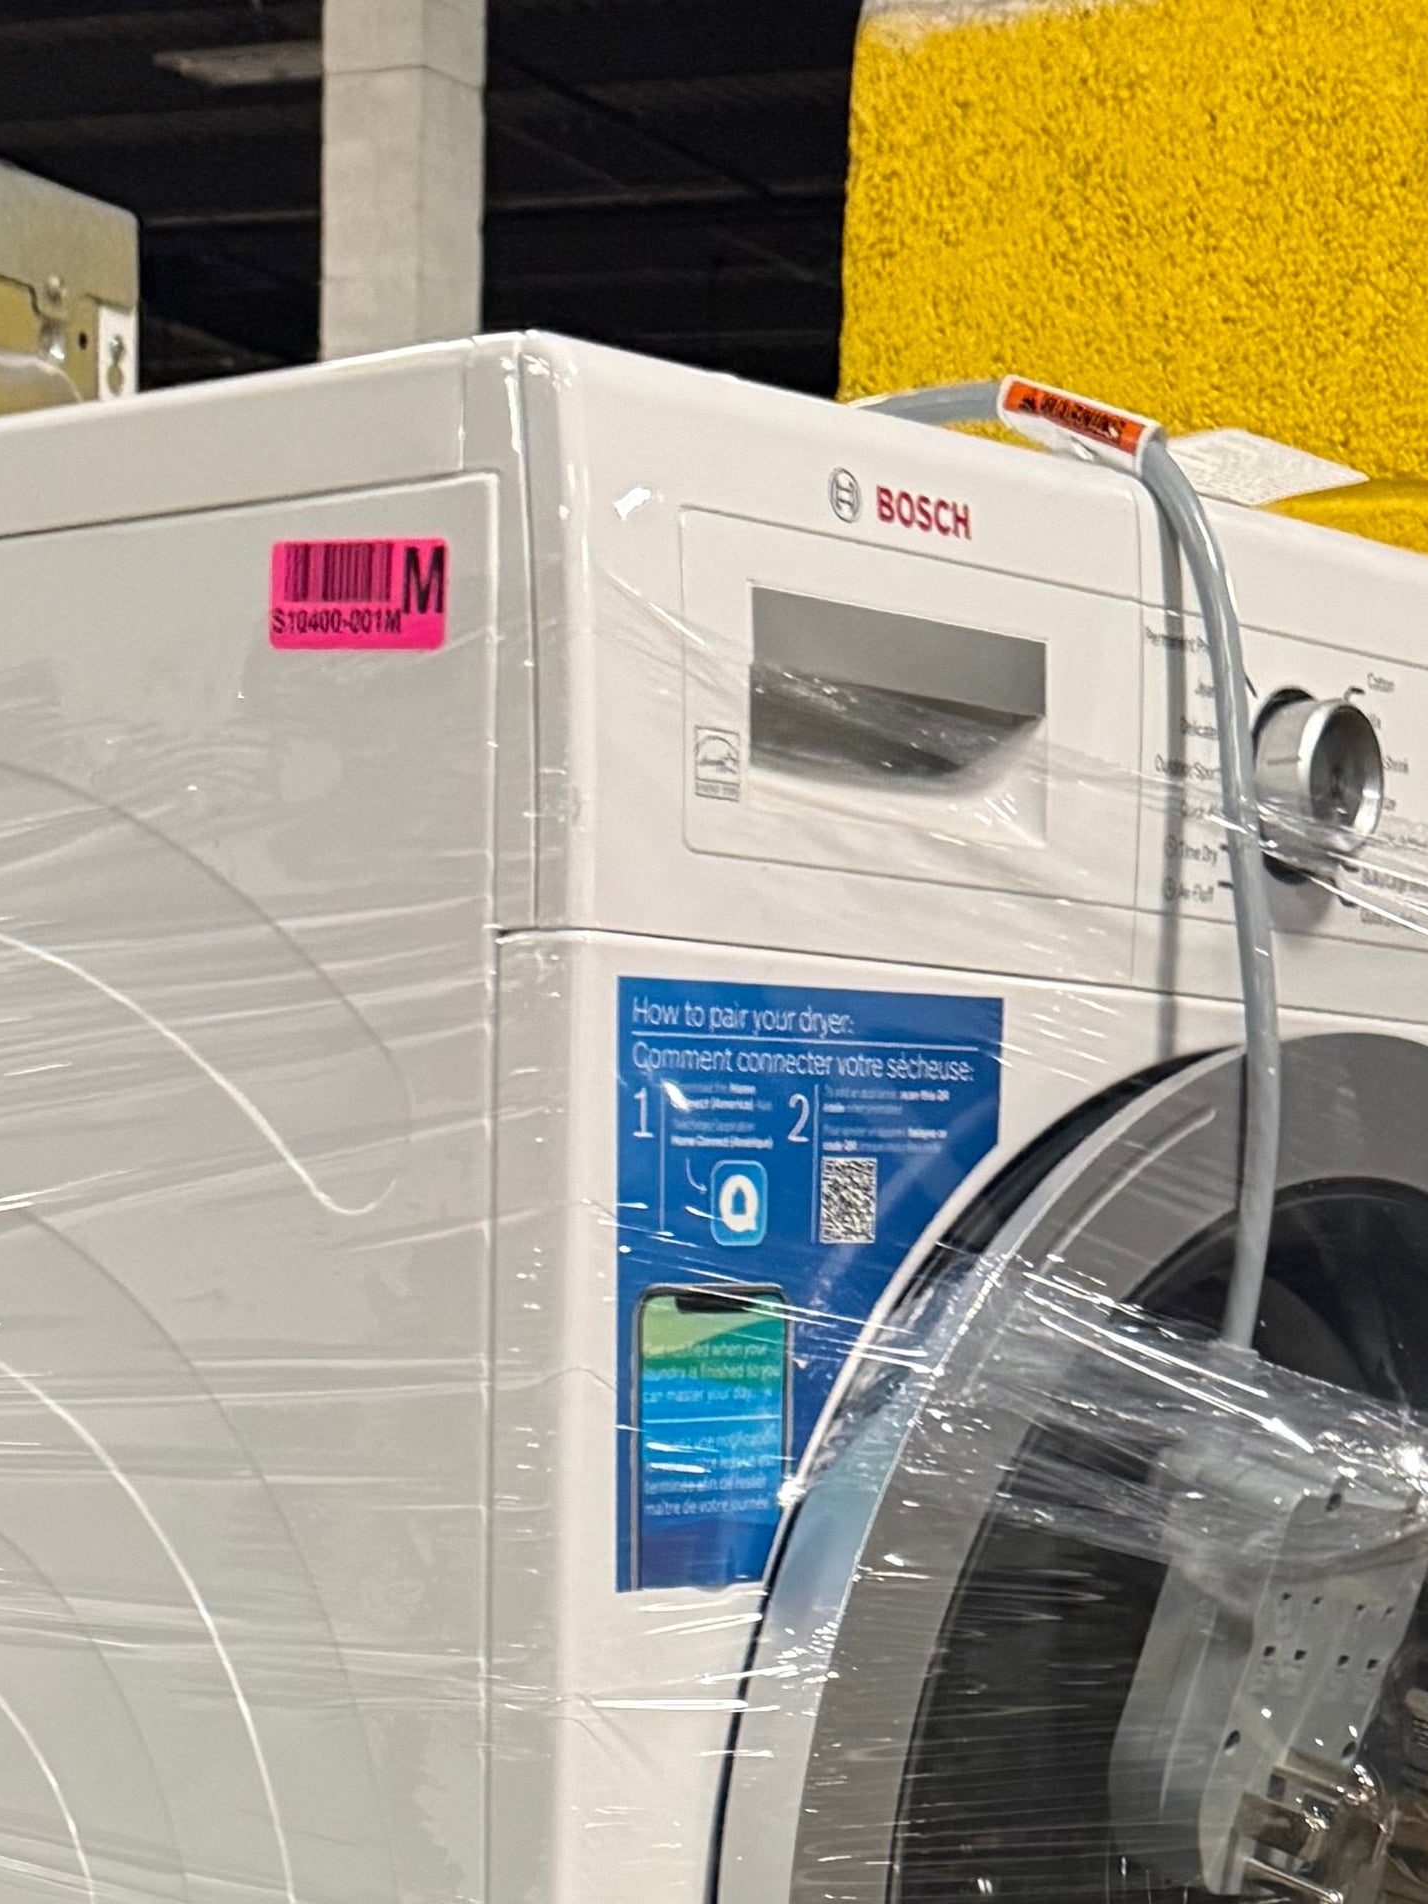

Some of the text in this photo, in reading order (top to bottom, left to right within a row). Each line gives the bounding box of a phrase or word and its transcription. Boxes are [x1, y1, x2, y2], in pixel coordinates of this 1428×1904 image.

[875, 485, 972, 541] BOSCH
[402, 545, 444, 615] M
[632, 996, 856, 1041] How to pair your dryer:
[632, 1041, 735, 1074] Comment
[736, 1048, 835, 1077] connecter
[836, 1053, 885, 1080] votre
[633, 1086, 655, 1140] 1
[787, 1092, 811, 1144] 2
